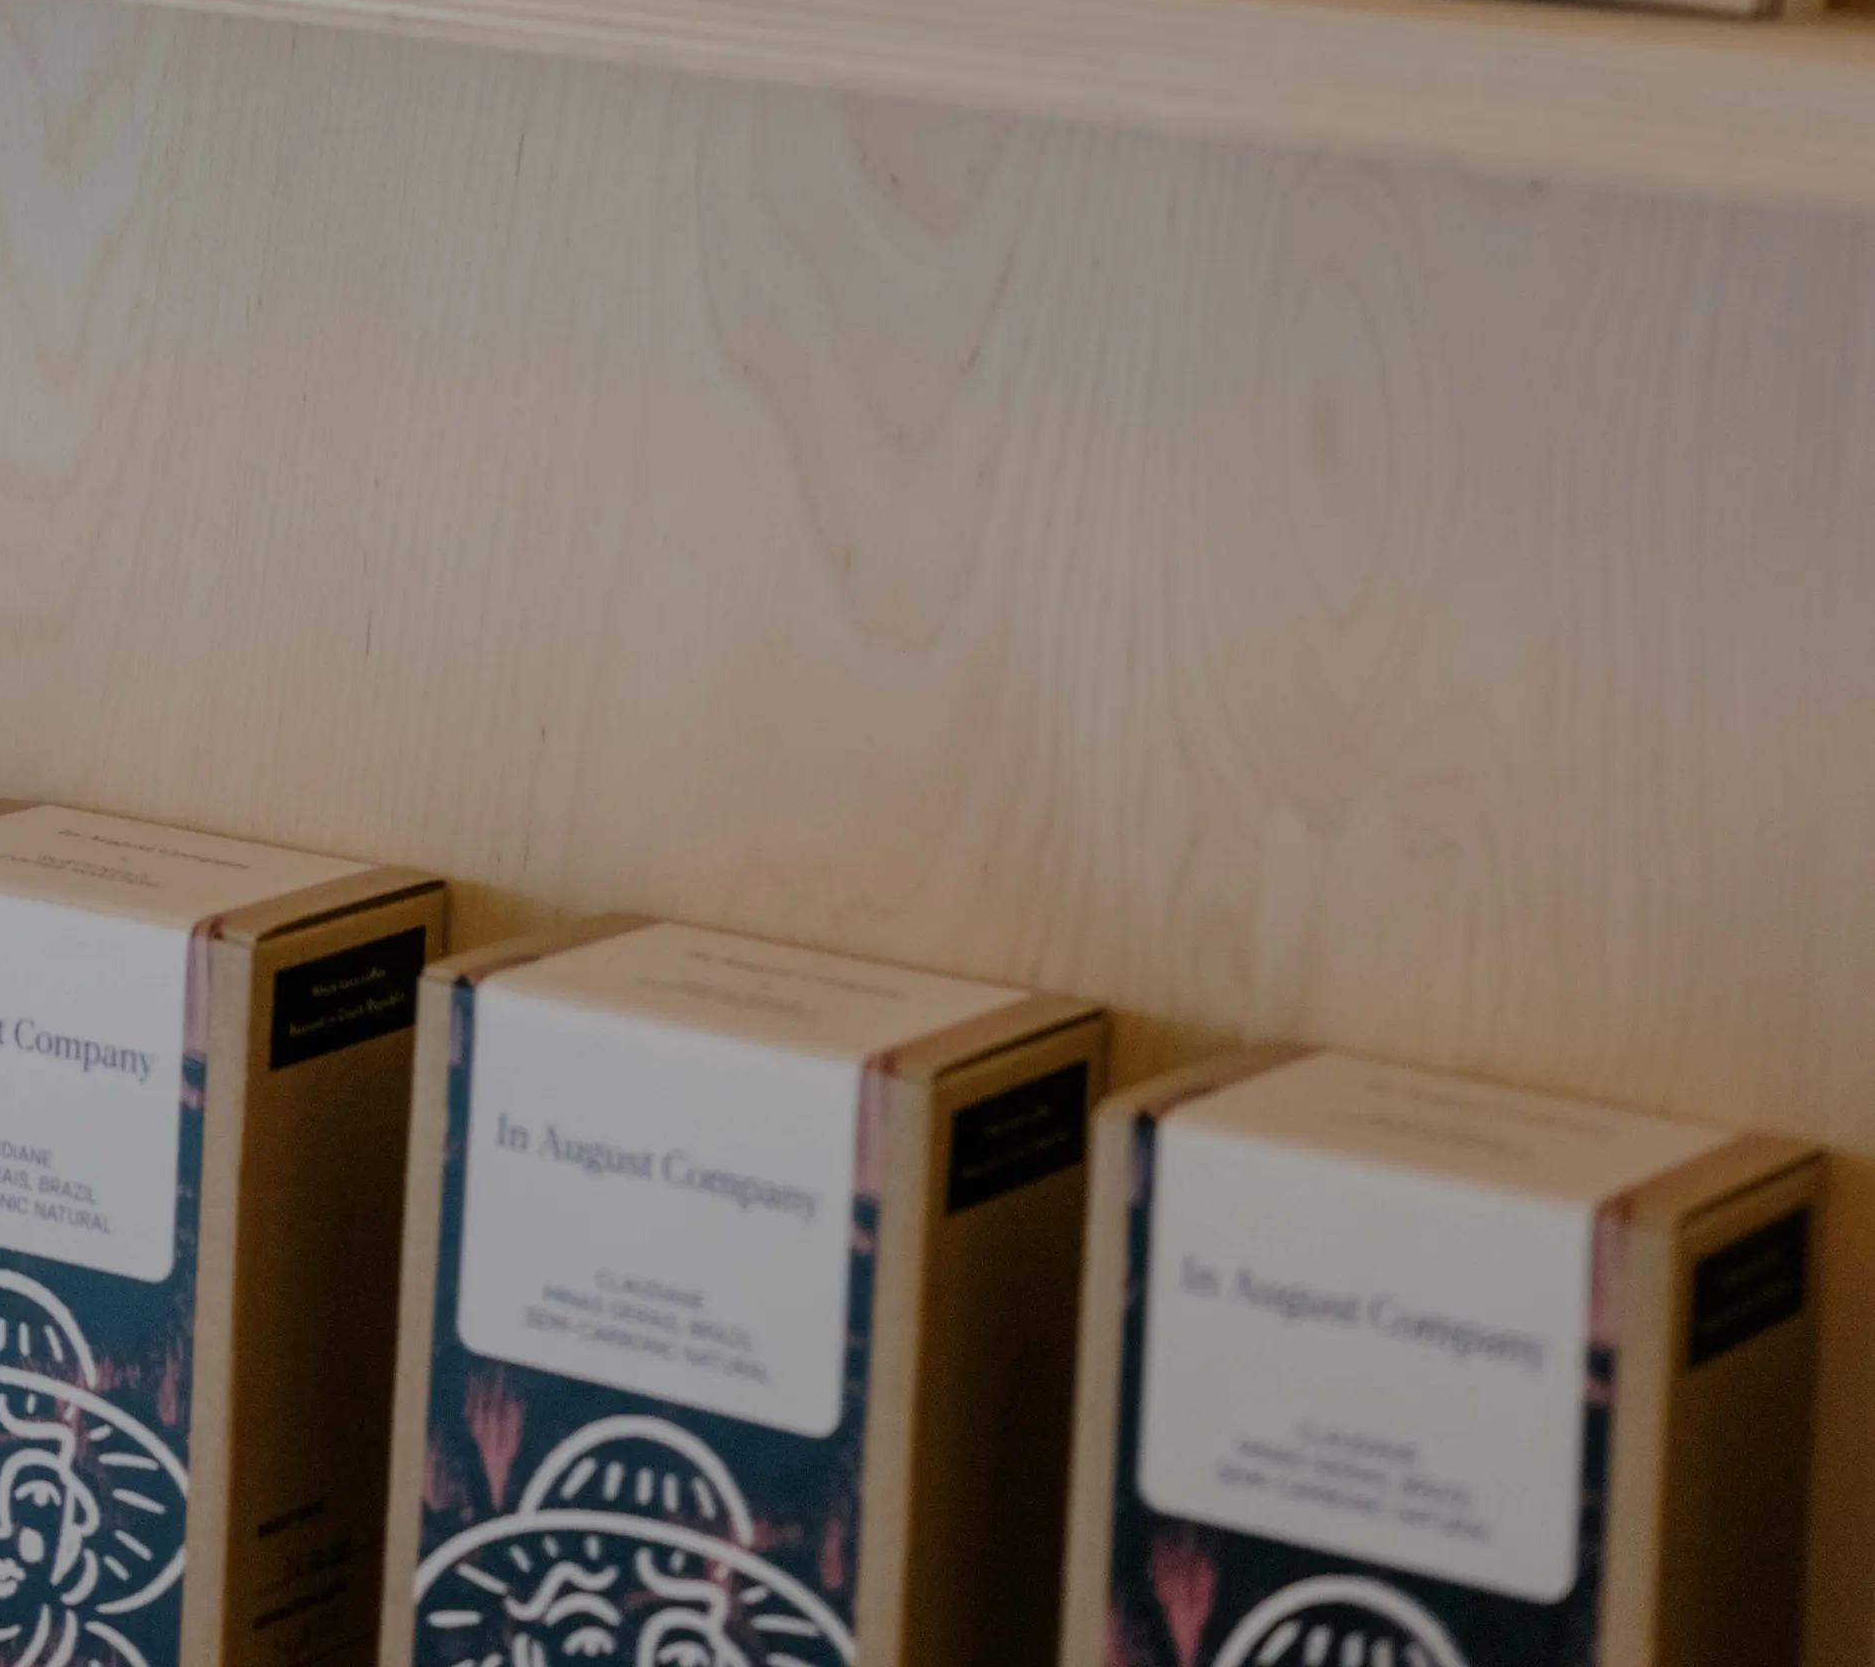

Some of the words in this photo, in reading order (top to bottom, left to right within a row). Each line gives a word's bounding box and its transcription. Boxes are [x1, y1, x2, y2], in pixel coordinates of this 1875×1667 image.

[14, 1018, 155, 1084] Company
[38, 1174, 97, 1206] BRAZIL
[494, 1112, 530, 1153] In
[536, 1125, 654, 1181] August
[661, 1149, 819, 1223] Company
[33, 1200, 112, 1236] NATURAL
